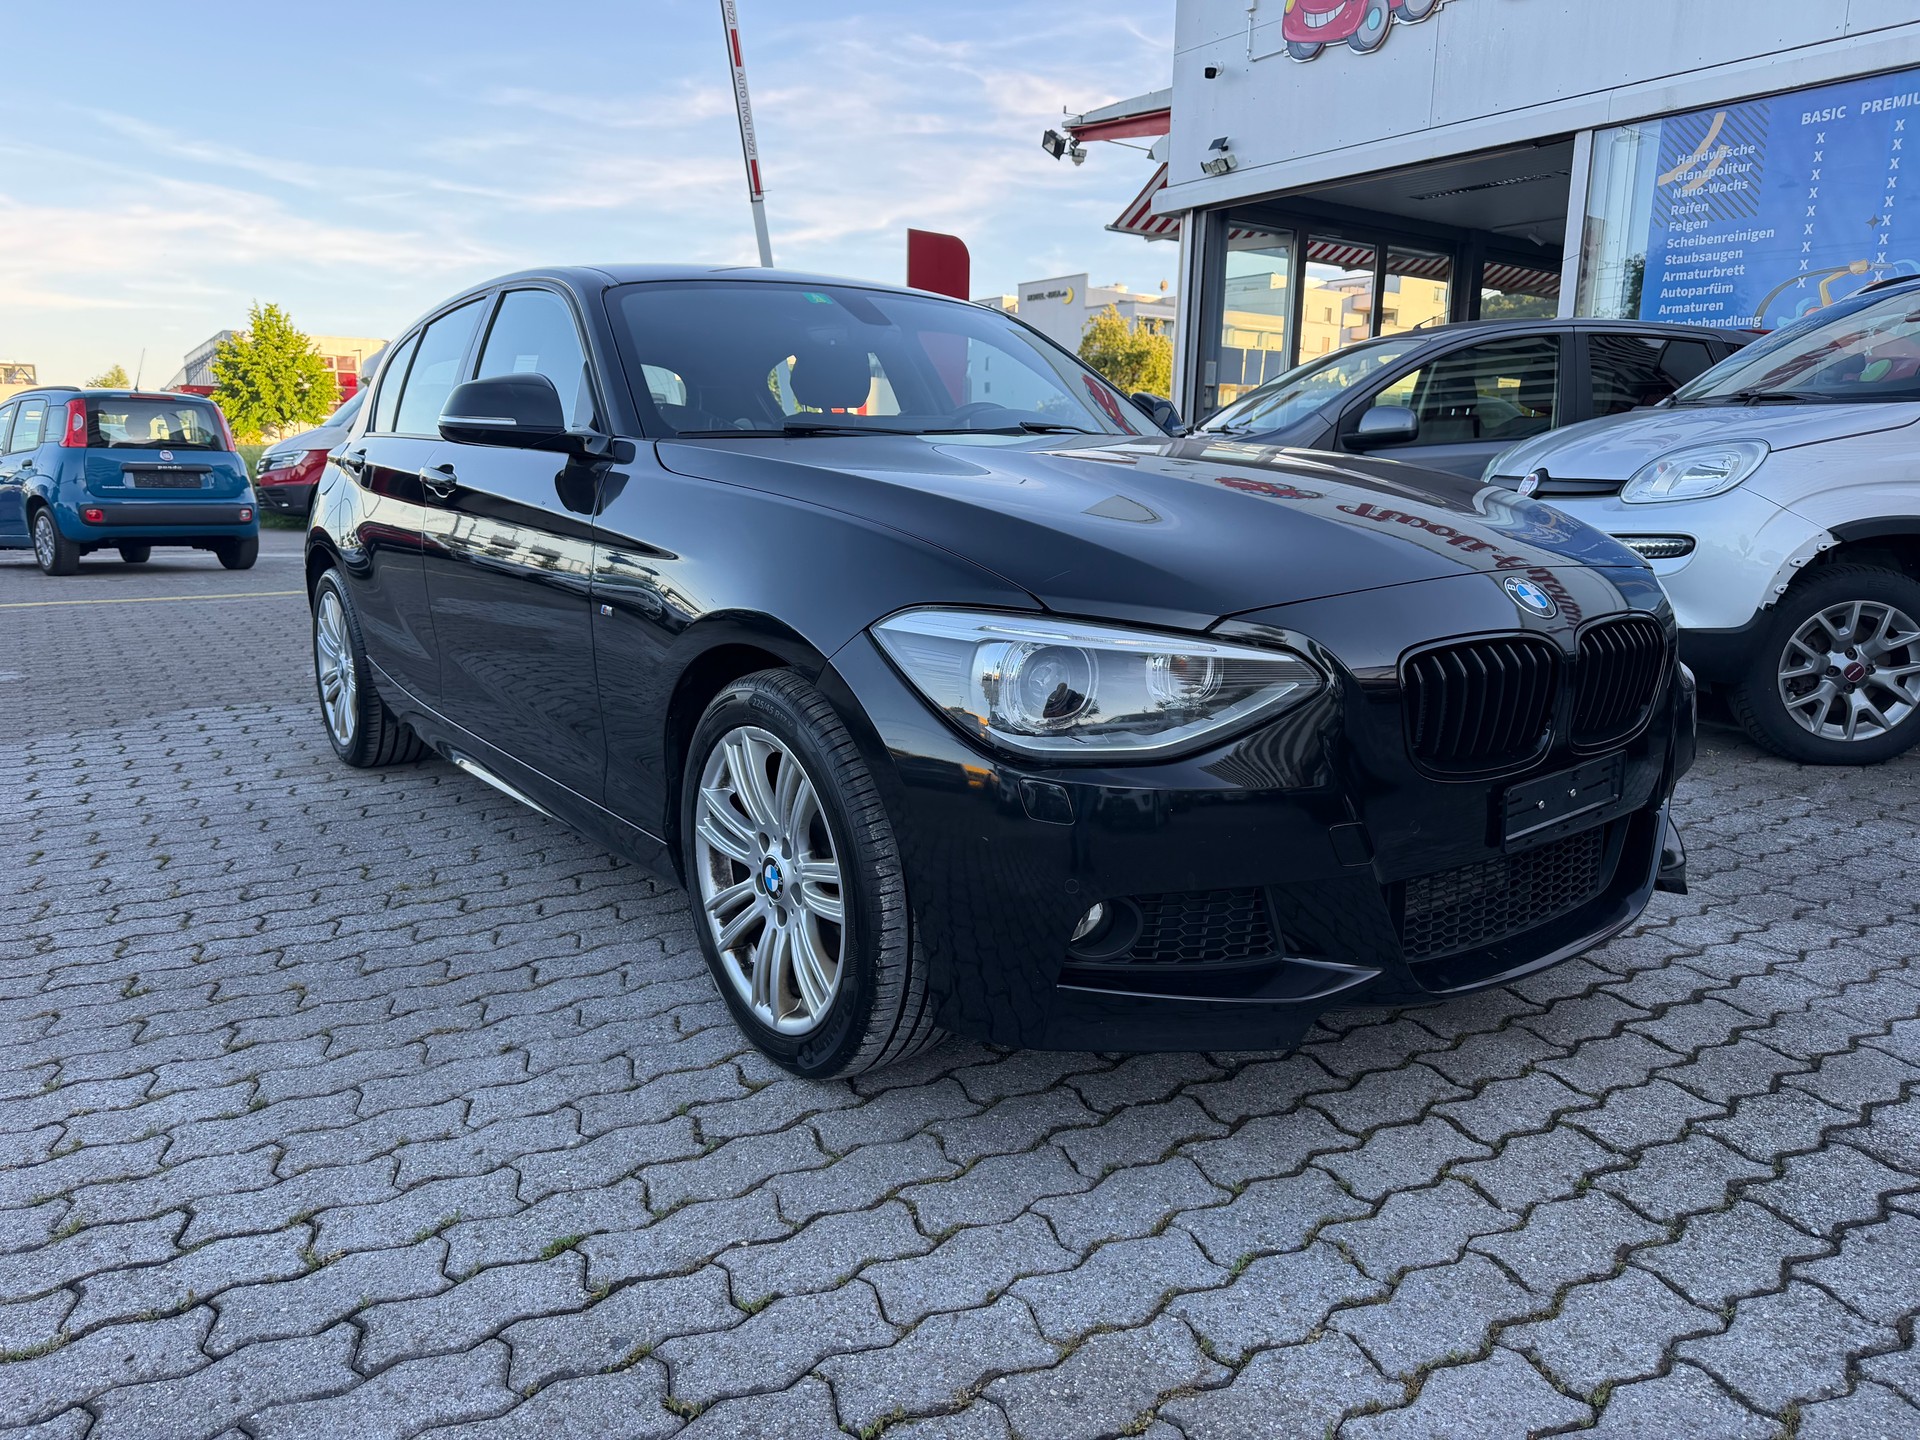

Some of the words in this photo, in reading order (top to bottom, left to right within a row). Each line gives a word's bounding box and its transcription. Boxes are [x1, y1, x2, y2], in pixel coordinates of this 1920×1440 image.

[737, 72, 746, 98] AUTO
[741, 102, 751, 130] TIVOLI
[1801, 106, 1846, 125] BASIC
[1895, 119, 1905, 131] X
[746, 133, 756, 155] PIZZI
[1816, 132, 1825, 144] X
[1892, 139, 1903, 150] X
[1677, 144, 1755, 164] Handwäsche
[1813, 151, 1823, 162] X
[1889, 157, 1900, 170] X
[1675, 163, 1753, 181] Glanzpolitur
[1811, 169, 1821, 180] X
[1887, 177, 1897, 188] X
[1673, 180, 1748, 198] Nano-Wachs
[1809, 187, 1818, 199] X
[1884, 196, 1894, 207] X
[1671, 202, 1709, 215] Reifen
[1807, 206, 1816, 216] X
[1669, 220, 1708, 232] Felgen
[1881, 215, 1891, 226] X
[1804, 224, 1813, 234] X
[1667, 229, 1774, 248] Scheibenreinigen
[1879, 234, 1889, 244] X
[1802, 242, 1811, 252] X
[1665, 250, 1743, 265] Staubsaugen
[1800, 260, 1808, 270] X
[1662, 265, 1745, 282] Armaturbrett
[1797, 277, 1806, 288] X
[1660, 283, 1733, 298] Autoparfüm
[1659, 302, 1723, 314] Armaturen
[753, 698, 774, 714] 225/45
